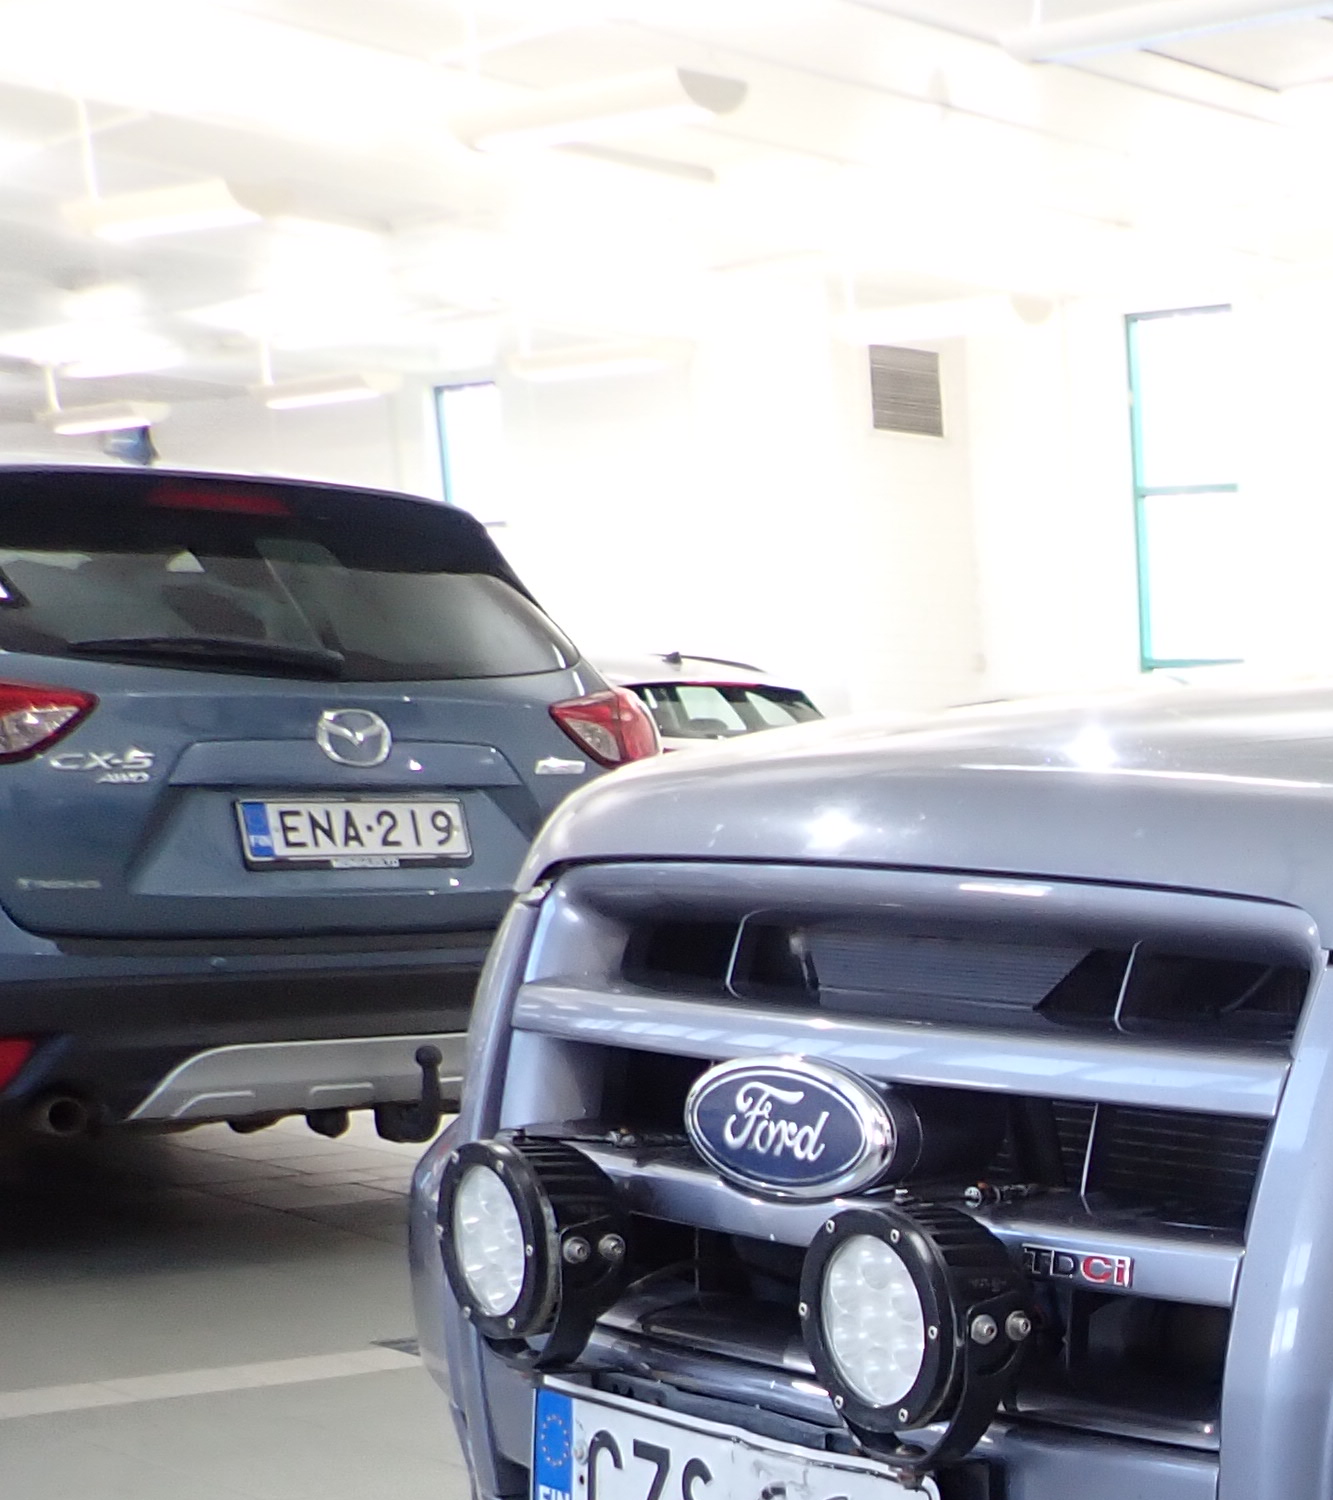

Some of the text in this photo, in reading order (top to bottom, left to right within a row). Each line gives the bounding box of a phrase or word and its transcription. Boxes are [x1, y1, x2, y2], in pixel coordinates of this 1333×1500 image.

[50, 749, 156, 770] CX-5
[278, 809, 453, 848] ENA-219
[723, 1081, 830, 1162] Ford
[1022, 1243, 1135, 1288] TDCi
